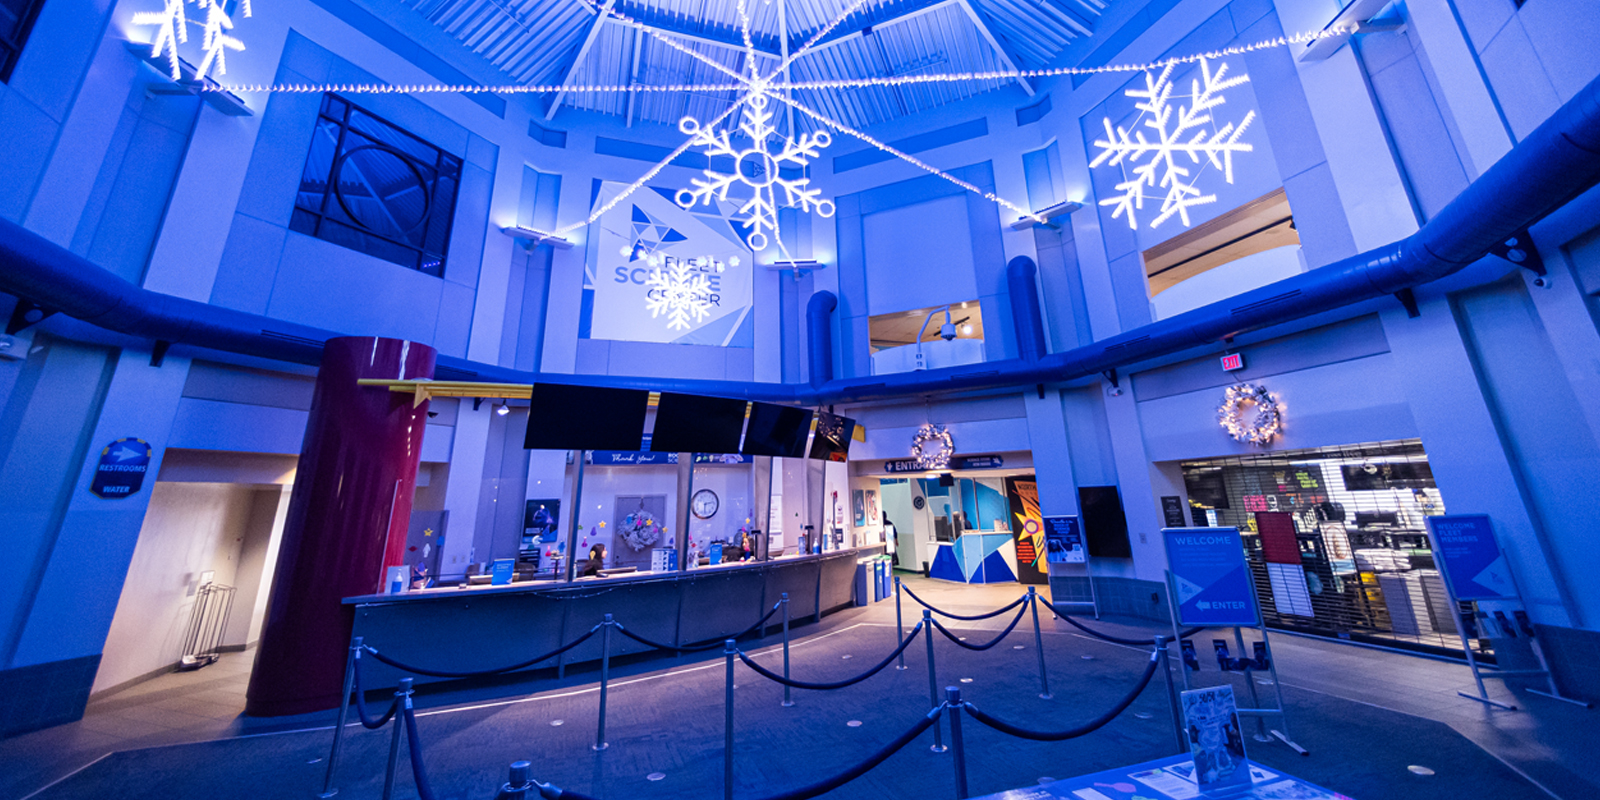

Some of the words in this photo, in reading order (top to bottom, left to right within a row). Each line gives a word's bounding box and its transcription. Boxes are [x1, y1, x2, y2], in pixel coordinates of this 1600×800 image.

[614, 266, 721, 292] SCCE
[1222, 354, 1240, 370] EXIT
[99, 464, 147, 473] RESTROOMS
[1436, 522, 1476, 530] WELCOME
[1438, 529, 1462, 537] FLEET
[1175, 536, 1232, 545] WELCOME
[1211, 601, 1246, 610] ENTER
